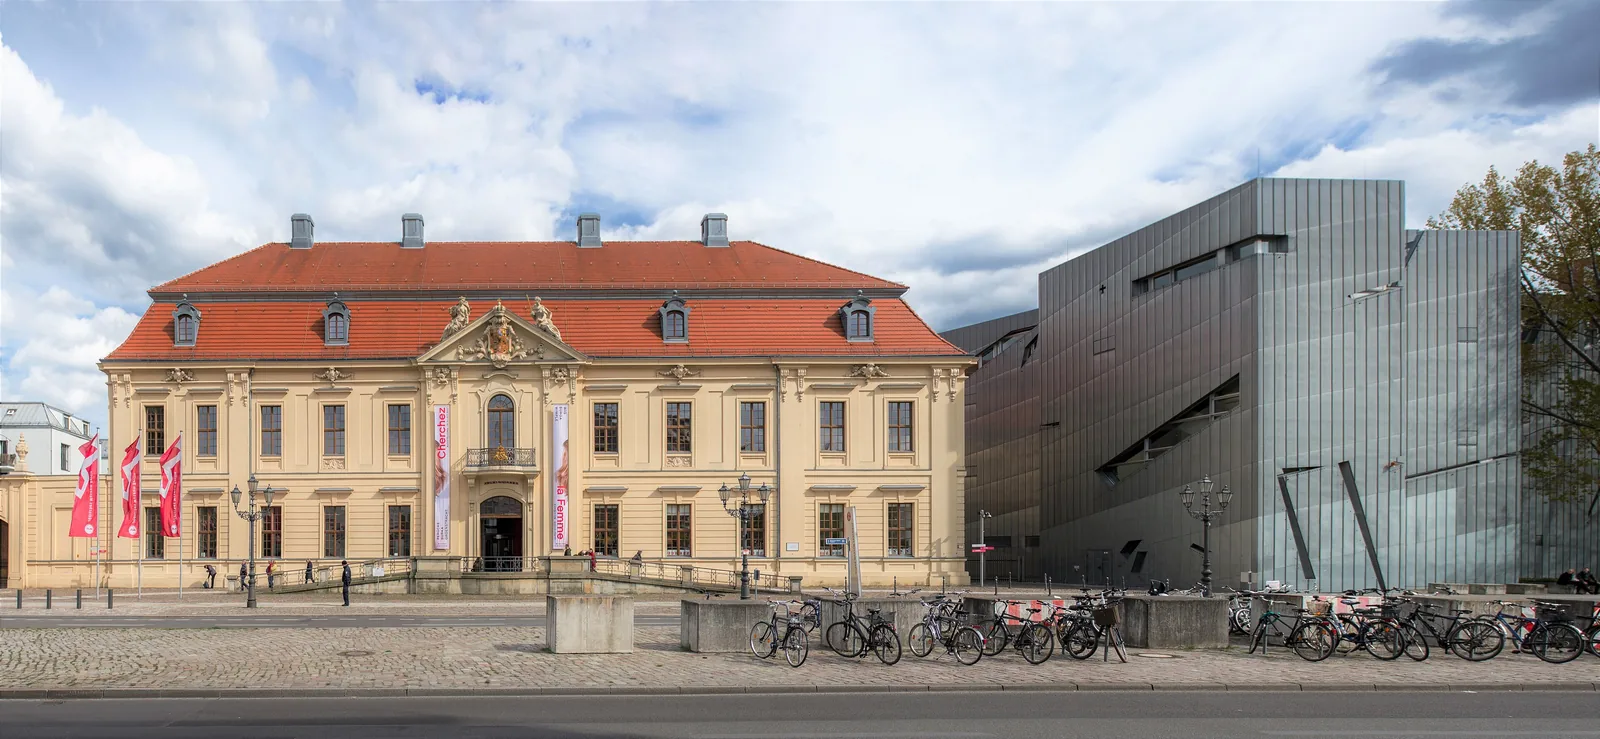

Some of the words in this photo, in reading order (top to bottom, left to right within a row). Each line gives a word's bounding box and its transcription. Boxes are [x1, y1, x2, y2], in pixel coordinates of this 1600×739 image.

[437, 407, 446, 459] Cherchez
[557, 485, 566, 495] la
[557, 499, 565, 540] Femme
